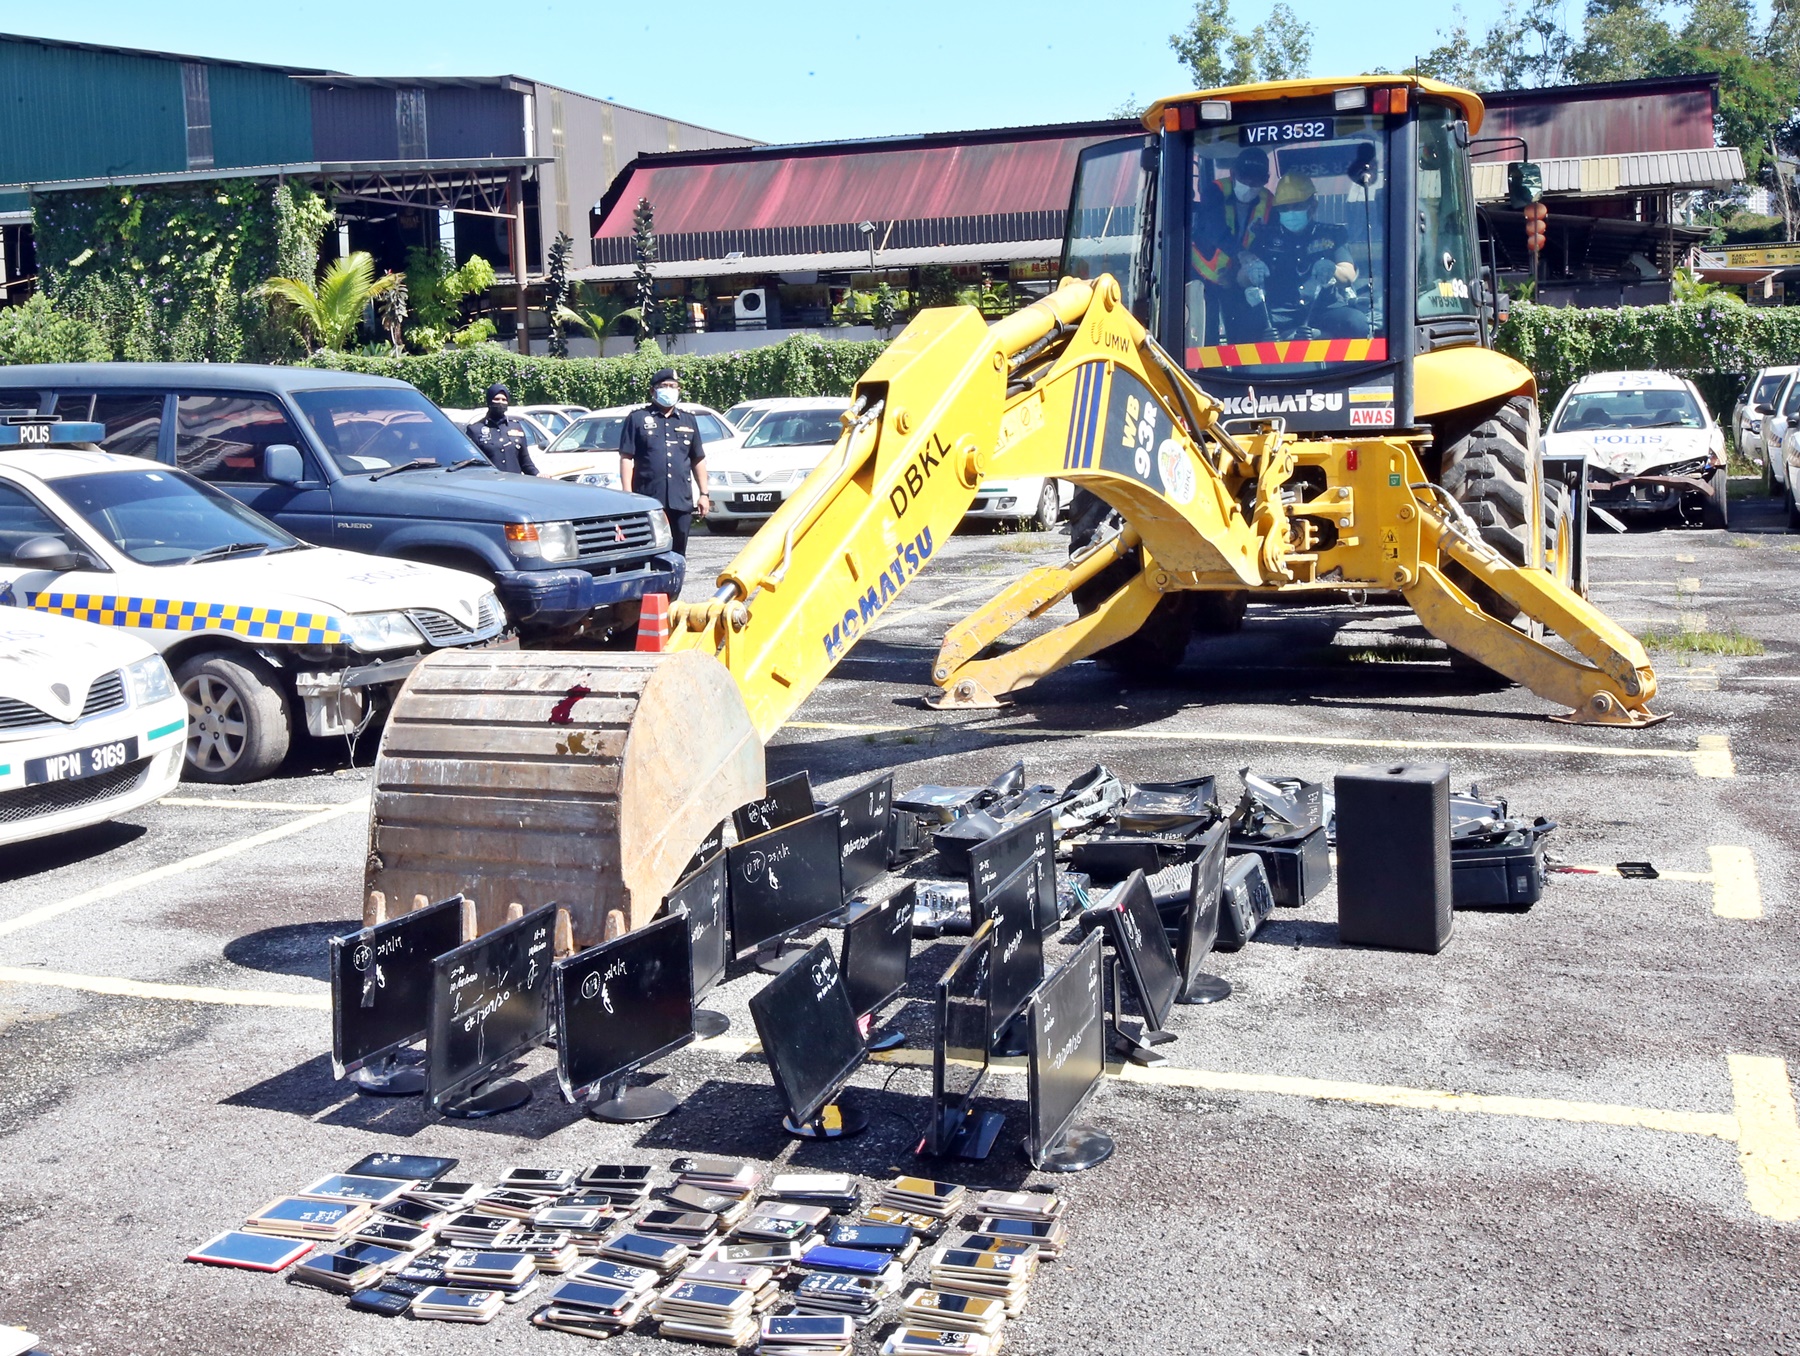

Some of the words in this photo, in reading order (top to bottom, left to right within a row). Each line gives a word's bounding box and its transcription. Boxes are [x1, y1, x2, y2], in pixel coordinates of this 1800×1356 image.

[1247, 126, 1278, 143] VFR
[1282, 122, 1325, 140] 3532
[1104, 333, 1130, 353] UMW
[1223, 389, 1343, 415] KOMATSU
[1122, 394, 1140, 449] WB
[1352, 409, 1393, 424] AWAS
[20, 425, 50, 443] POLIS
[1593, 434, 1663, 444] POLIS
[889, 433, 952, 519] DBKL
[756, 493, 773, 502] 4727
[822, 525, 934, 663] KOMATSU
[45, 752, 82, 780] WPN
[91, 742, 126, 771] 3169
